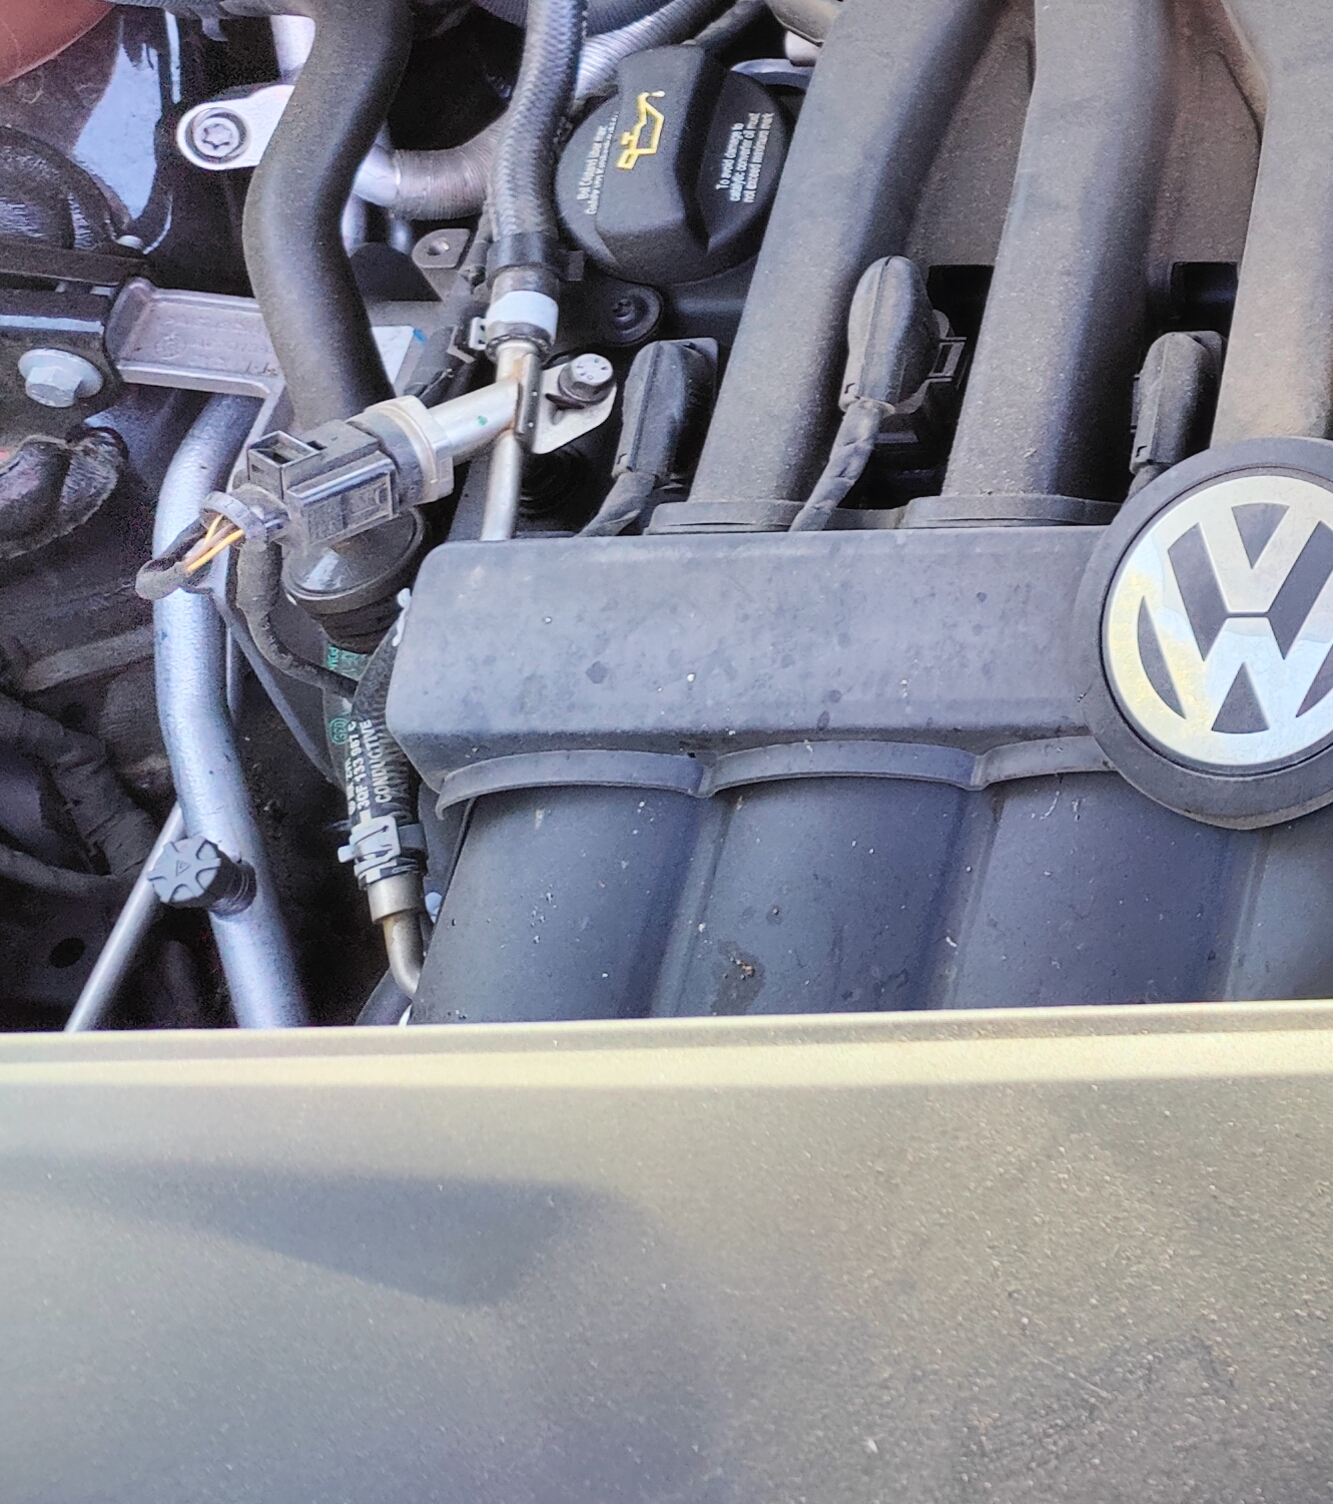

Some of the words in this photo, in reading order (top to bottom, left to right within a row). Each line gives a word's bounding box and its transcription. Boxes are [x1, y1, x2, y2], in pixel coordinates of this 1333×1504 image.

[731, 122, 745, 130] to
[746, 112, 761, 129] must
[724, 130, 743, 158] damage
[741, 129, 756, 139] oil
[735, 139, 754, 171] converter
[720, 158, 735, 179] avoid
[745, 163, 762, 190] exceed
[714, 178, 731, 190] To
[741, 190, 756, 203] not
[353, 757, 367, 782] 133
[359, 718, 393, 803] CONDUCTIVE
